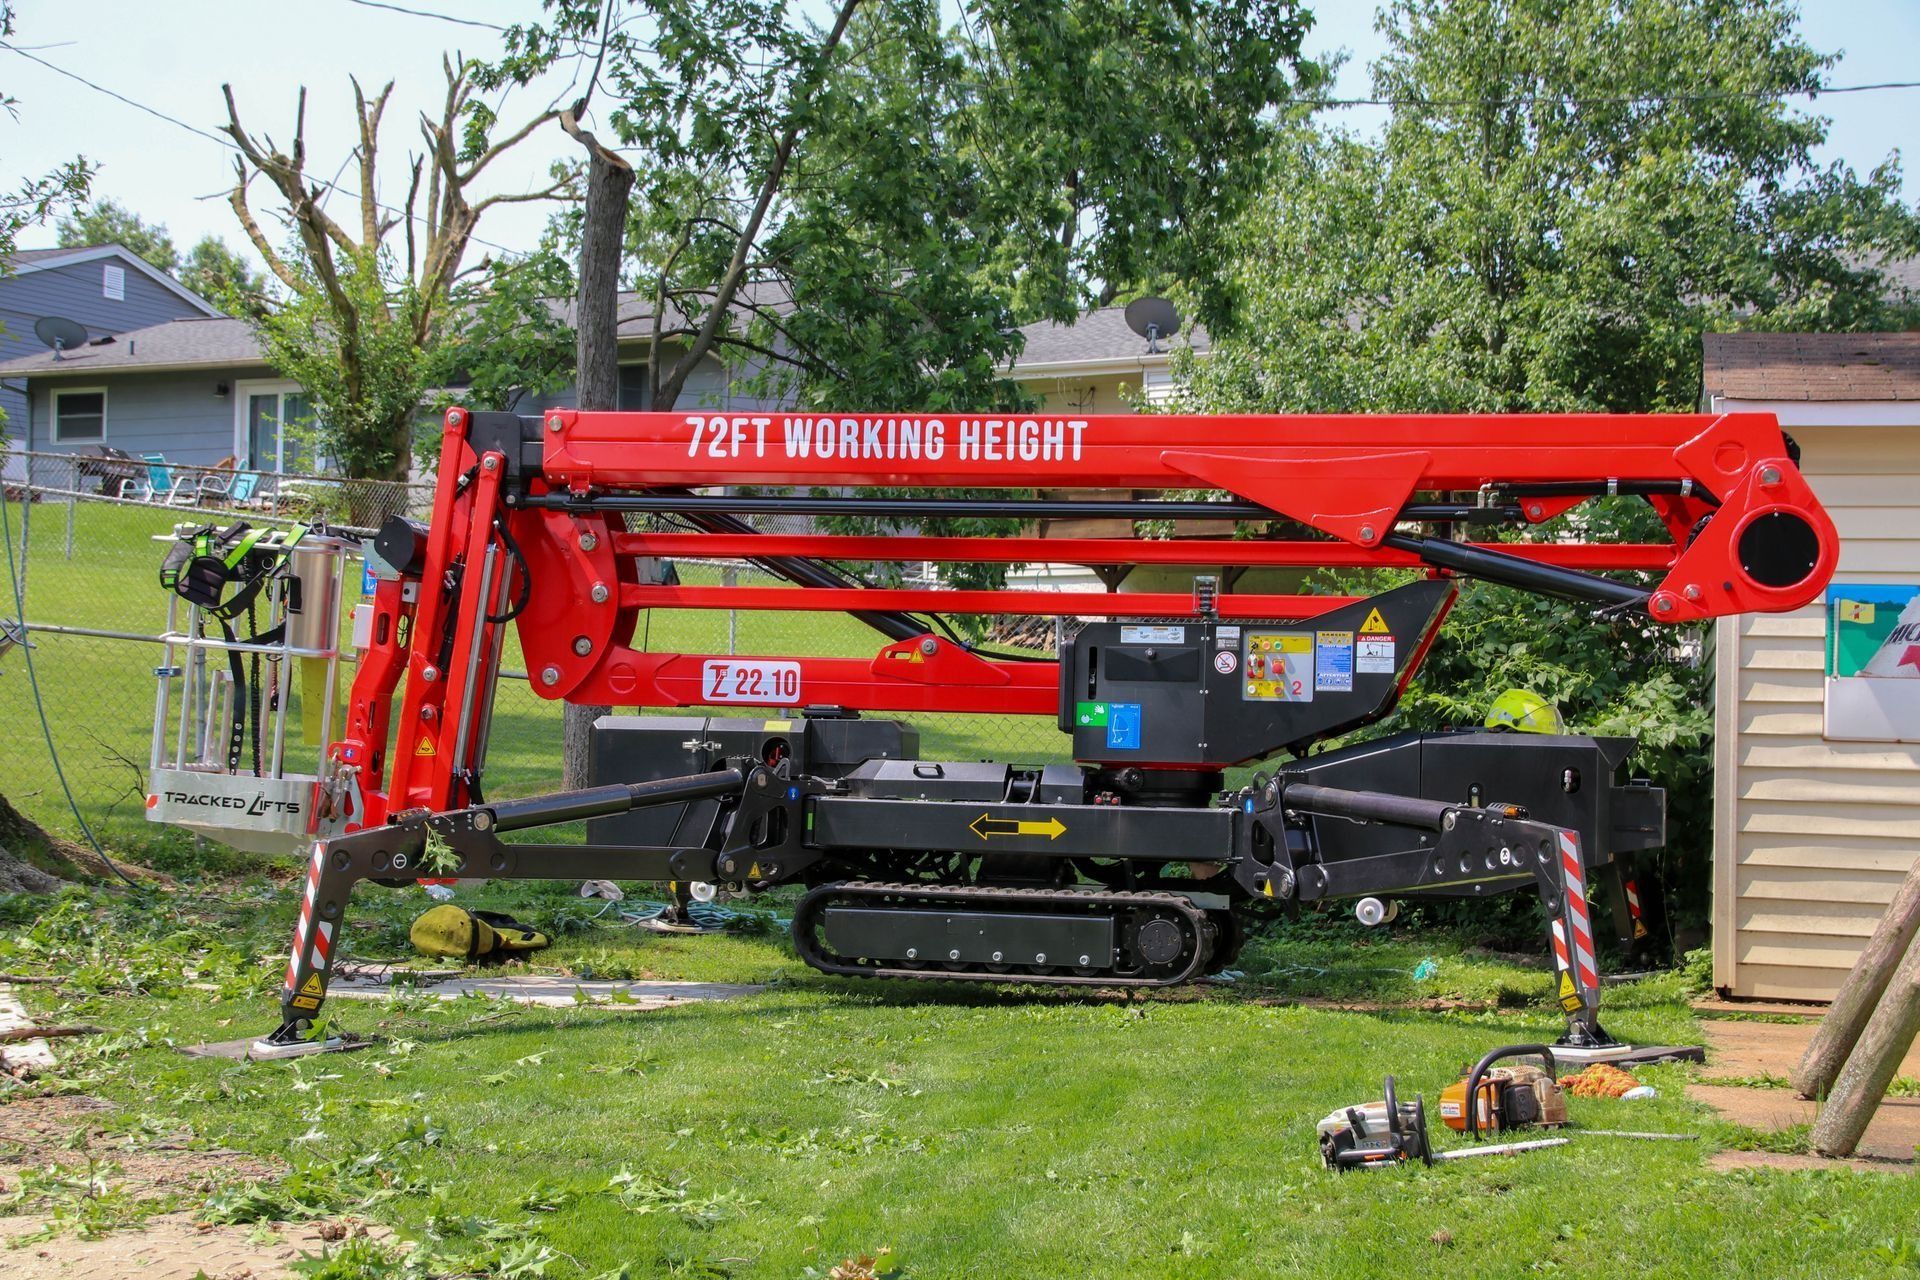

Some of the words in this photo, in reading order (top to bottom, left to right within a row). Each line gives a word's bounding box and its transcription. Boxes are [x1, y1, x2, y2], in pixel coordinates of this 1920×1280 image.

[685, 416, 771, 459] 72FT
[784, 417, 945, 461] WORKING
[960, 419, 1088, 462] HEIGHT
[735, 668, 797, 697] 22.10
[1291, 680, 1303, 696] 2
[164, 791, 246, 809] TRACKED
[246, 791, 300, 817] LIFTS
